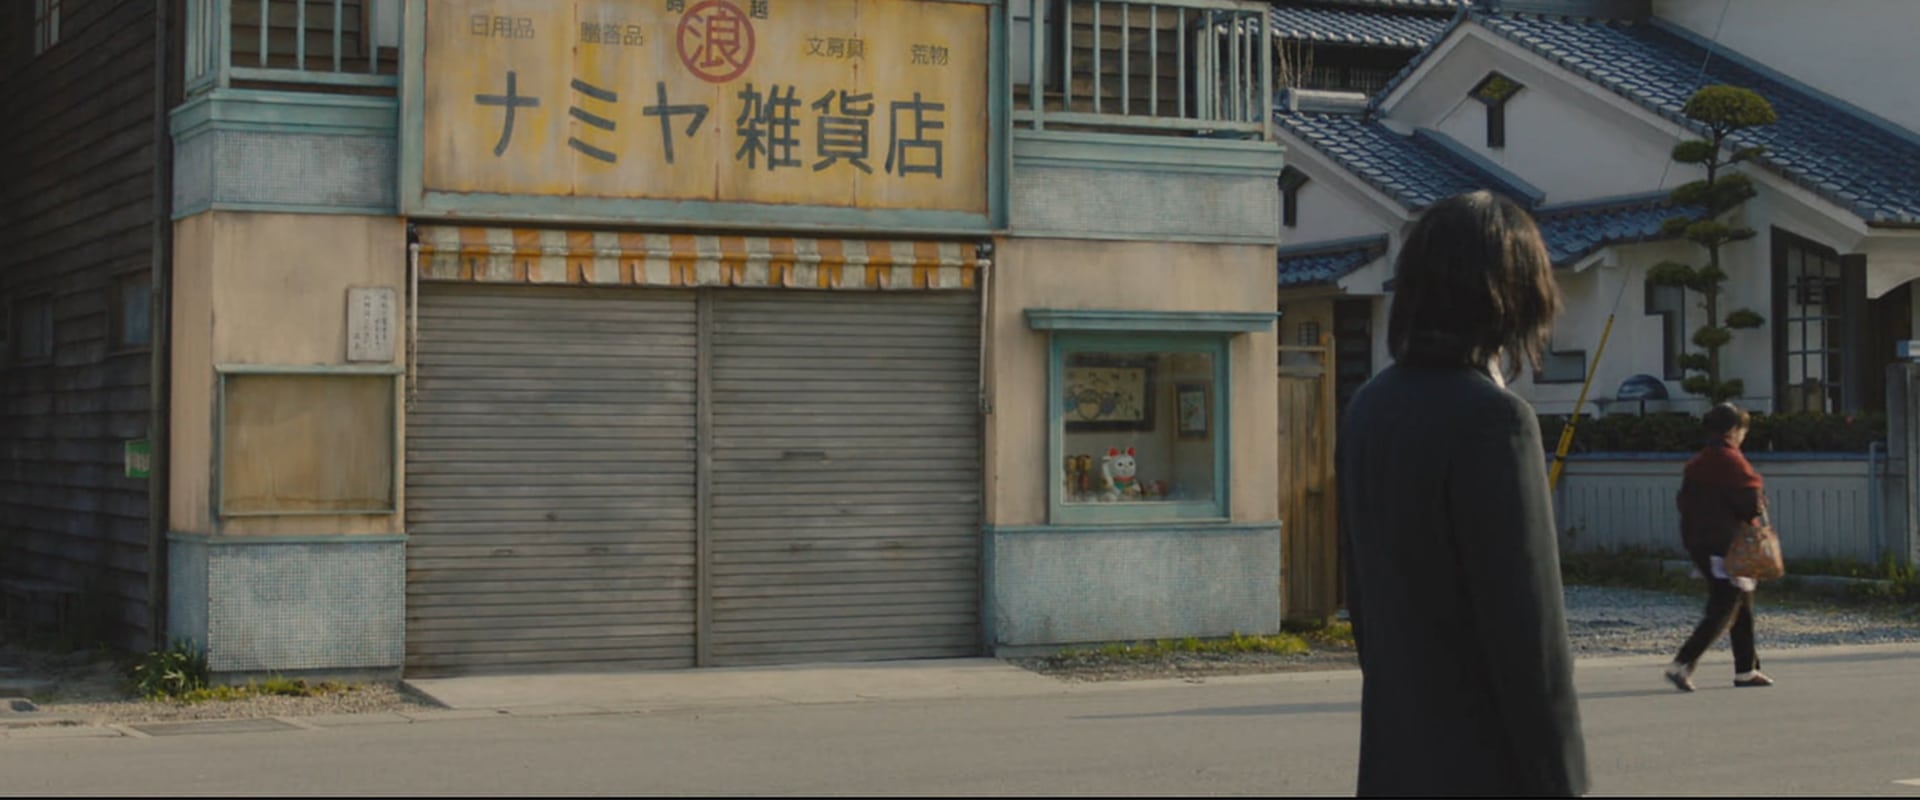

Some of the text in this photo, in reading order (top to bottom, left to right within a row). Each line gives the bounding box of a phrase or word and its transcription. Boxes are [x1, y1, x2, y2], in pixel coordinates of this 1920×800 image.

[471, 14, 535, 40] 日用品
[684, 6, 742, 70] 浪
[806, 37, 865, 60] 文房具
[911, 43, 950, 66] 荒物
[474, 71, 945, 178] ナミヤ雑貨店
